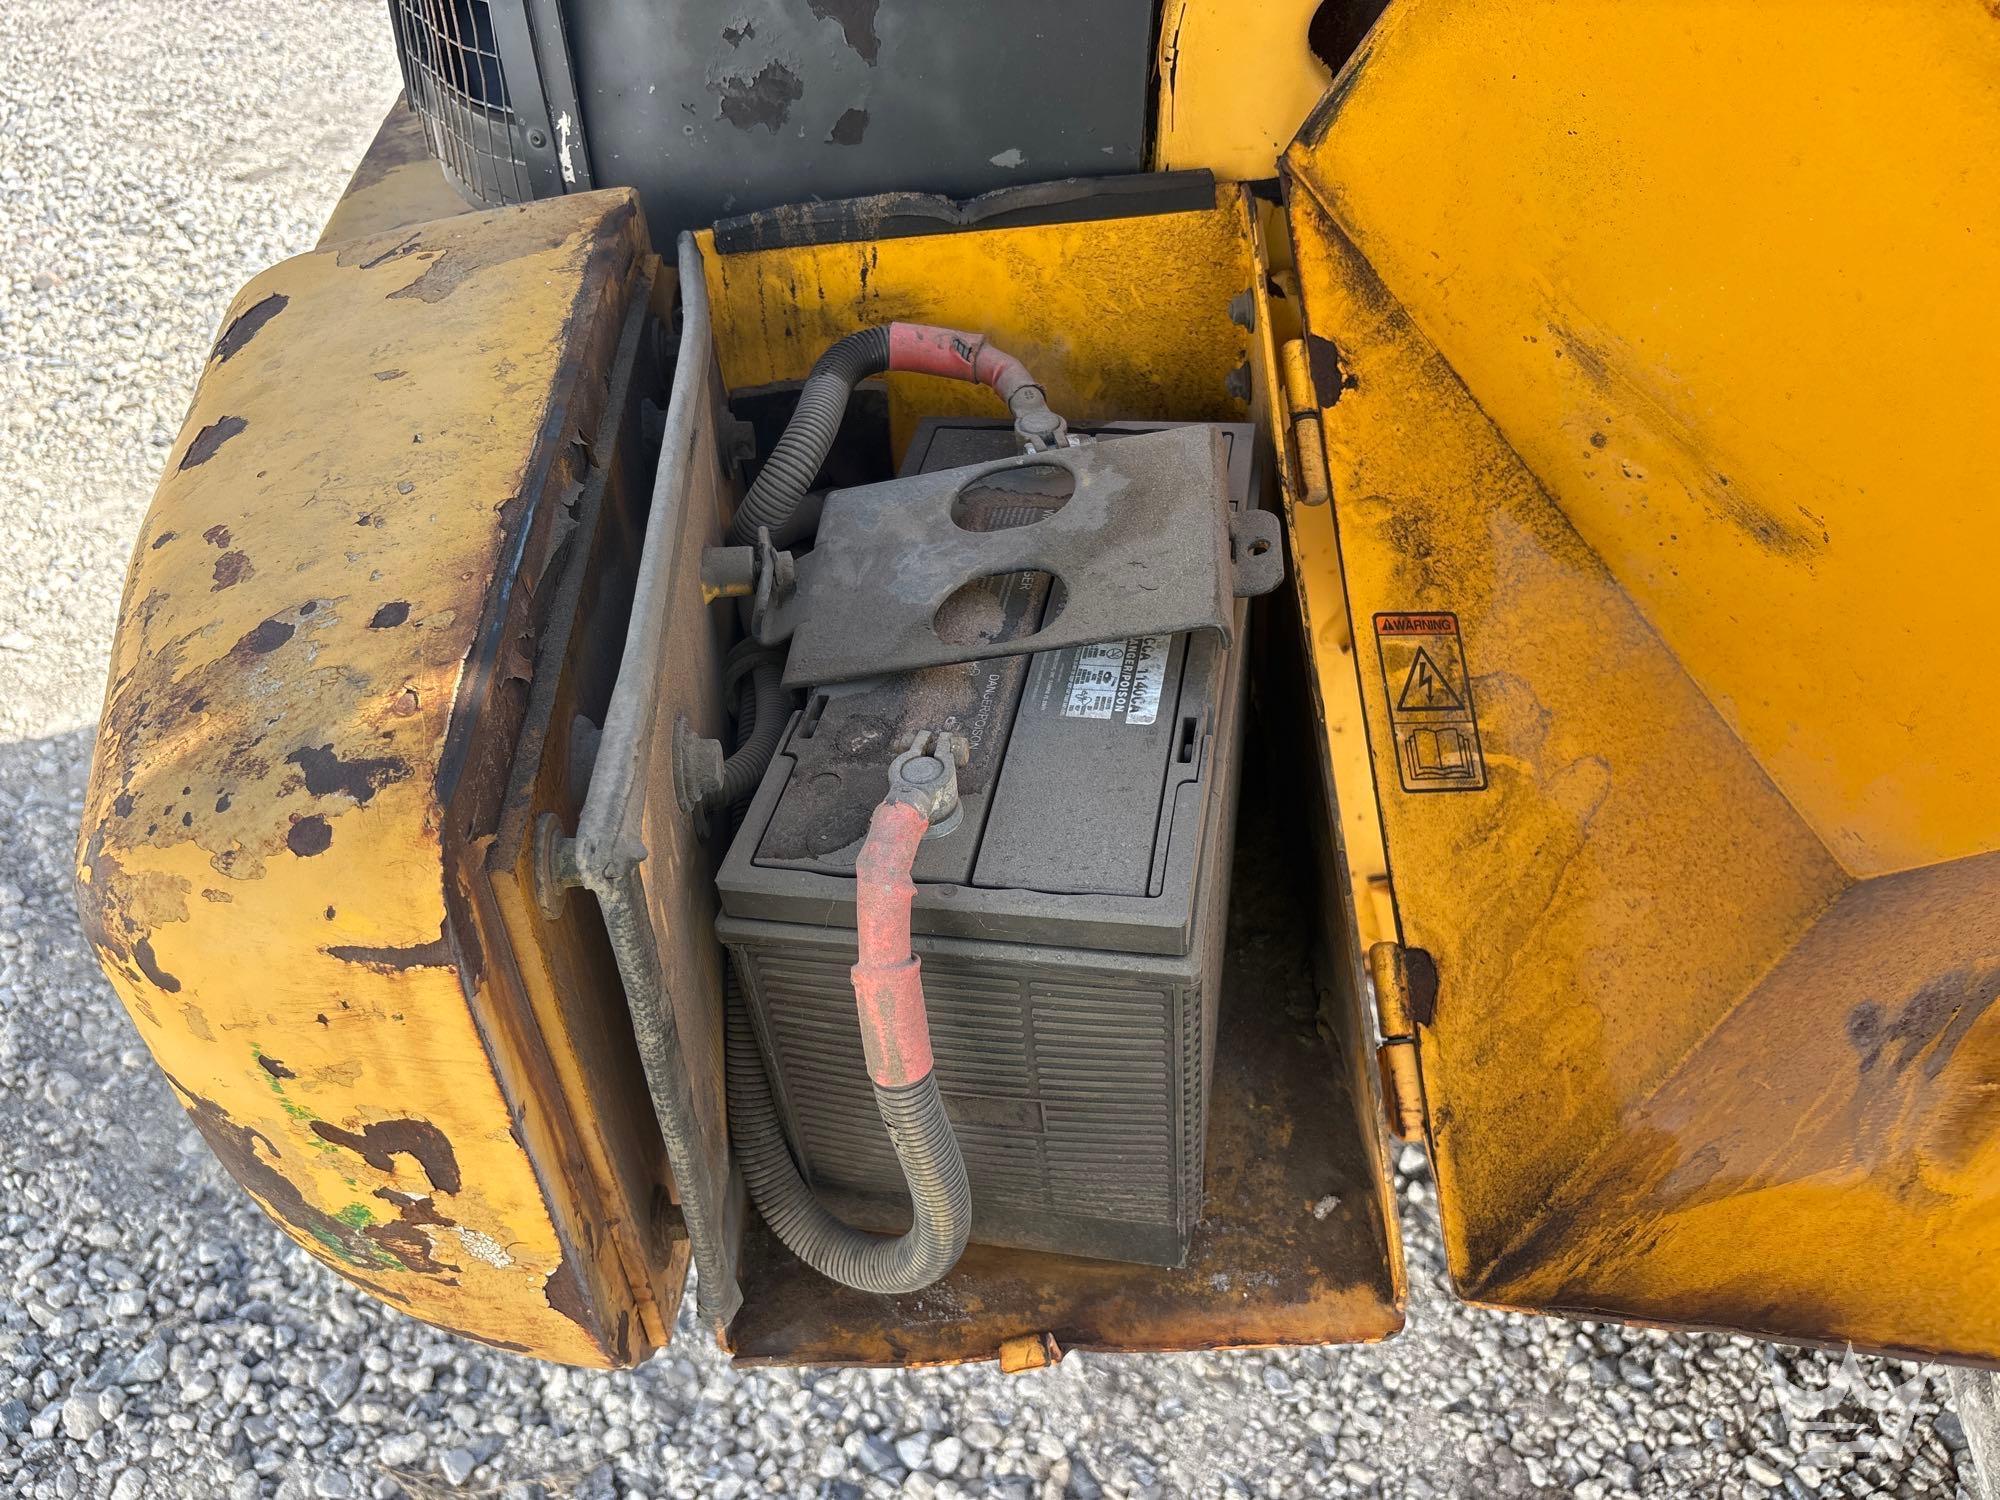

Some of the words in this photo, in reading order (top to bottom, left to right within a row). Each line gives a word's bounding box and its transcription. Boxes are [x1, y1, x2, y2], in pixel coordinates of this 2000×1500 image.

[1393, 619, 1451, 631] WARNING
[1114, 639, 1138, 713] ANGER/POISON
[1128, 668, 1149, 714] 1140CA
